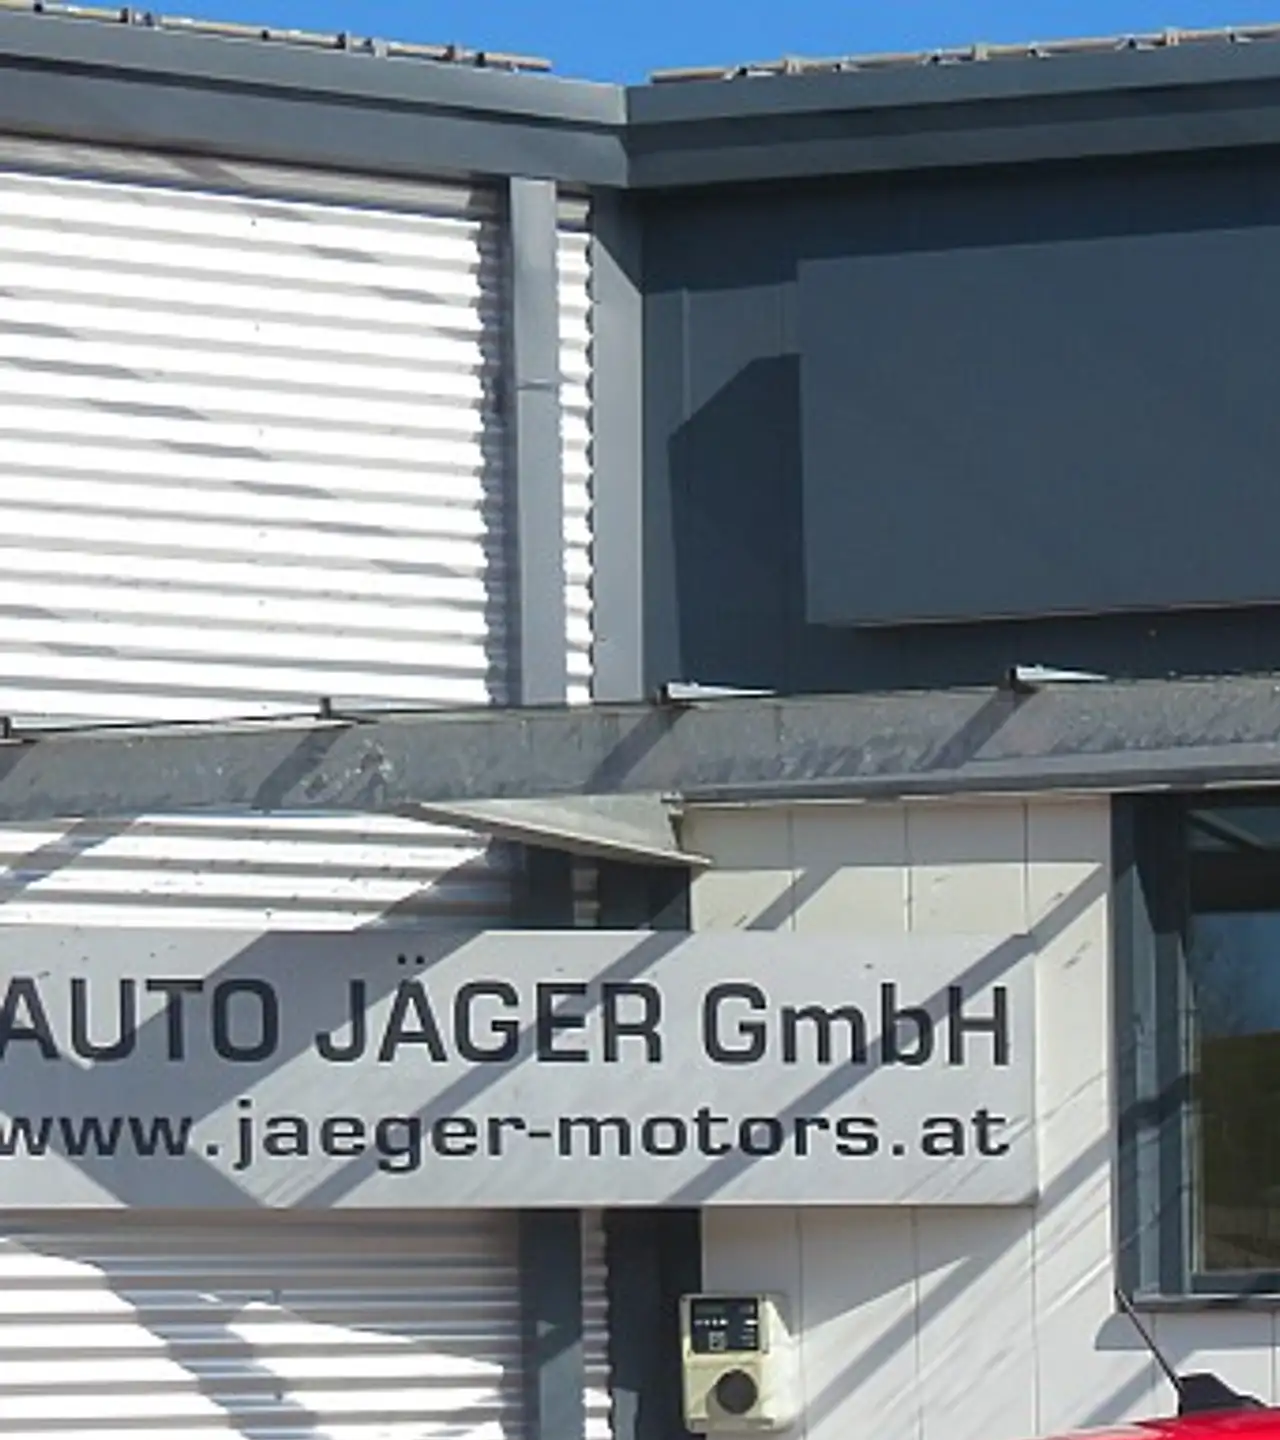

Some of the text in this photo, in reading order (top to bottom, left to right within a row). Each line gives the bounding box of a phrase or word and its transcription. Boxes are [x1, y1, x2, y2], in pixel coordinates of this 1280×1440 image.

[0, 953, 1008, 1066] AUTO JÄGER GmbH
[0, 1098, 1010, 1173] www.jaeger-motors.at
